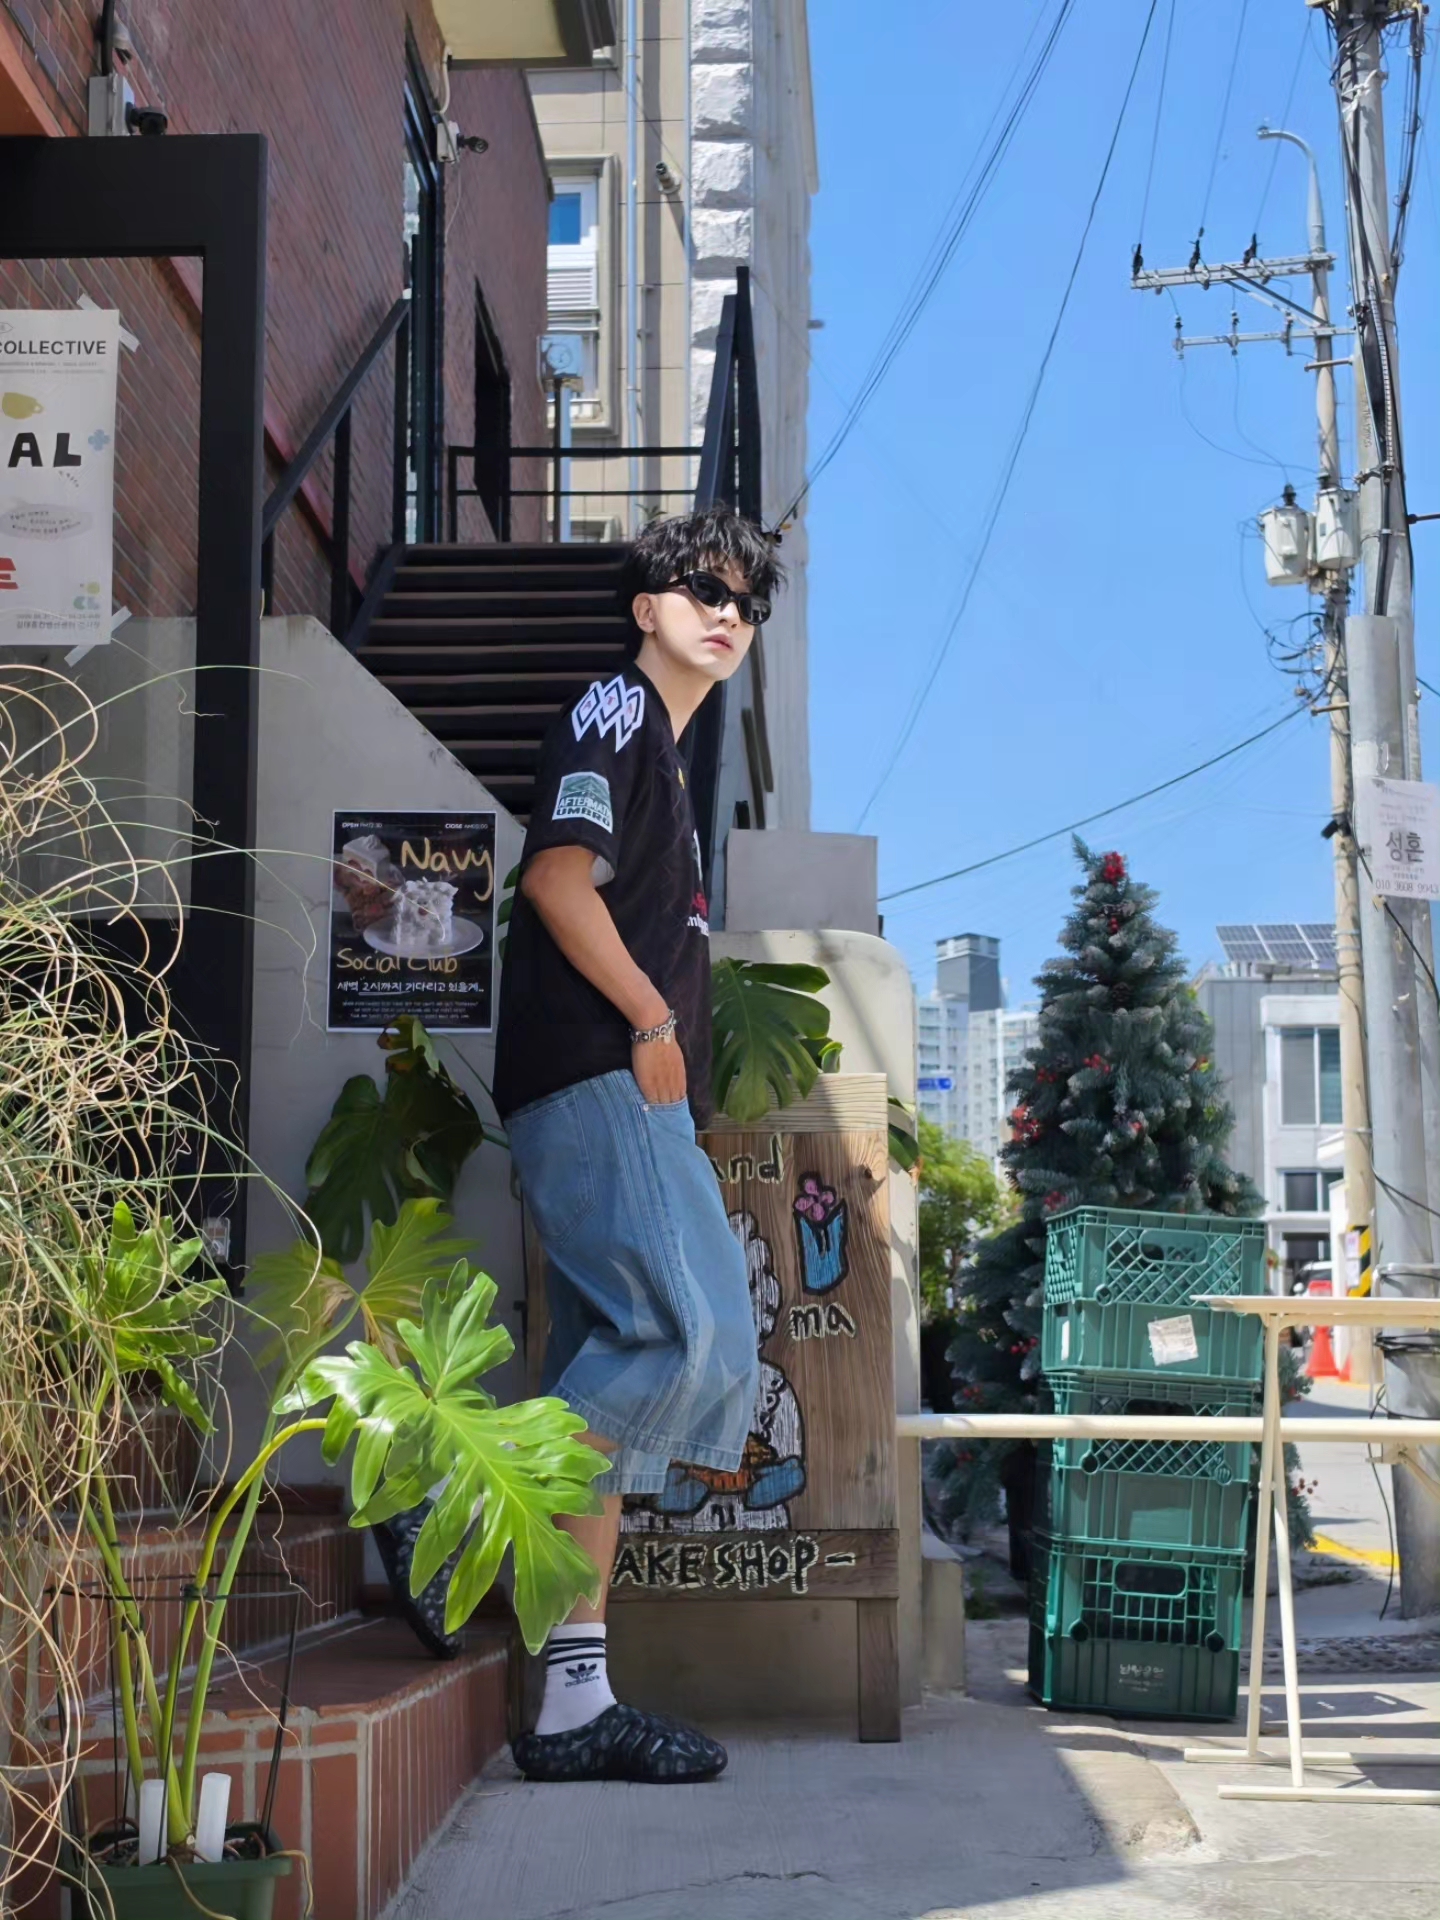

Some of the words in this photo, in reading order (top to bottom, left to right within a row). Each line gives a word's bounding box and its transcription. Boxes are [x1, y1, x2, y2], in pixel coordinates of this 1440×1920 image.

[0, 340, 106, 355] OLLECTIVE
[401, 836, 494, 902] Navy
[336, 948, 400, 974] Social
[712, 1535, 820, 1595] SHOP
[564, 1675, 601, 1688] adidas
